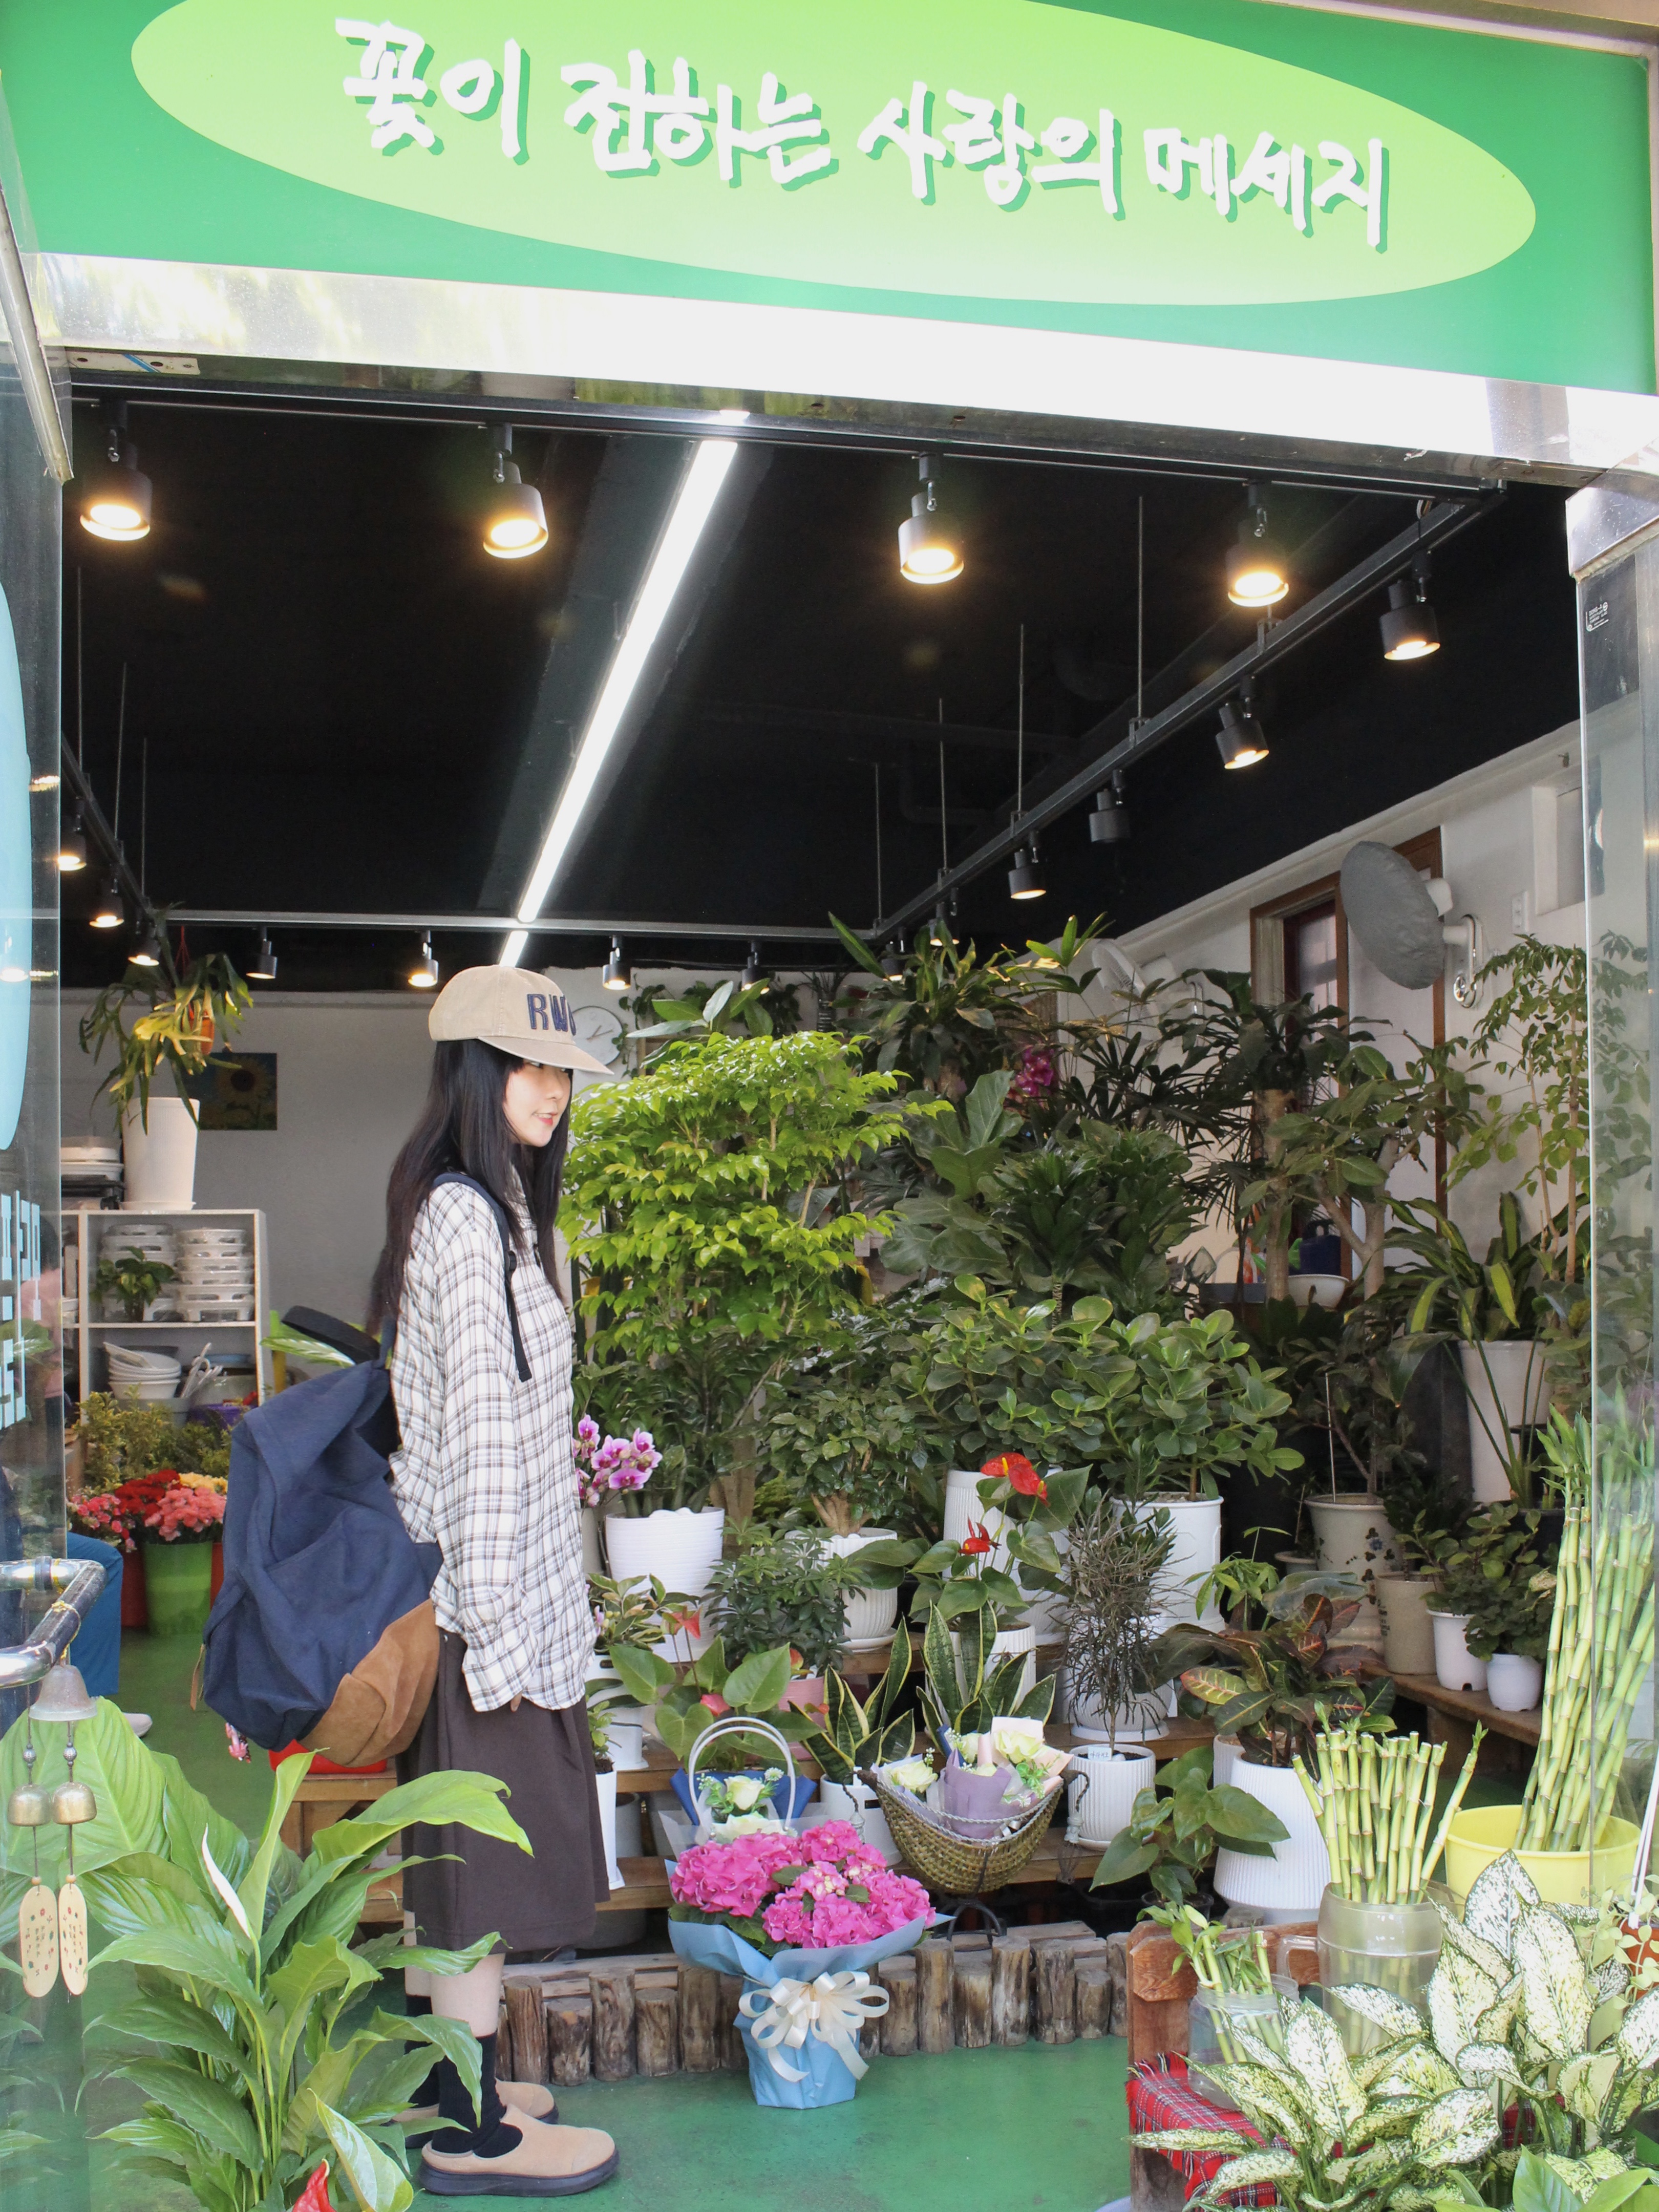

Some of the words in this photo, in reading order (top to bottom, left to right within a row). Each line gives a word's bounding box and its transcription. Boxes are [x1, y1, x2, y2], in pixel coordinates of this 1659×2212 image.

[335, 18, 526, 160] 꽃이
[561, 49, 836, 186] 전하는
[857, 81, 1122, 216] 사랑의
[1143, 127, 1387, 250] 메세지
